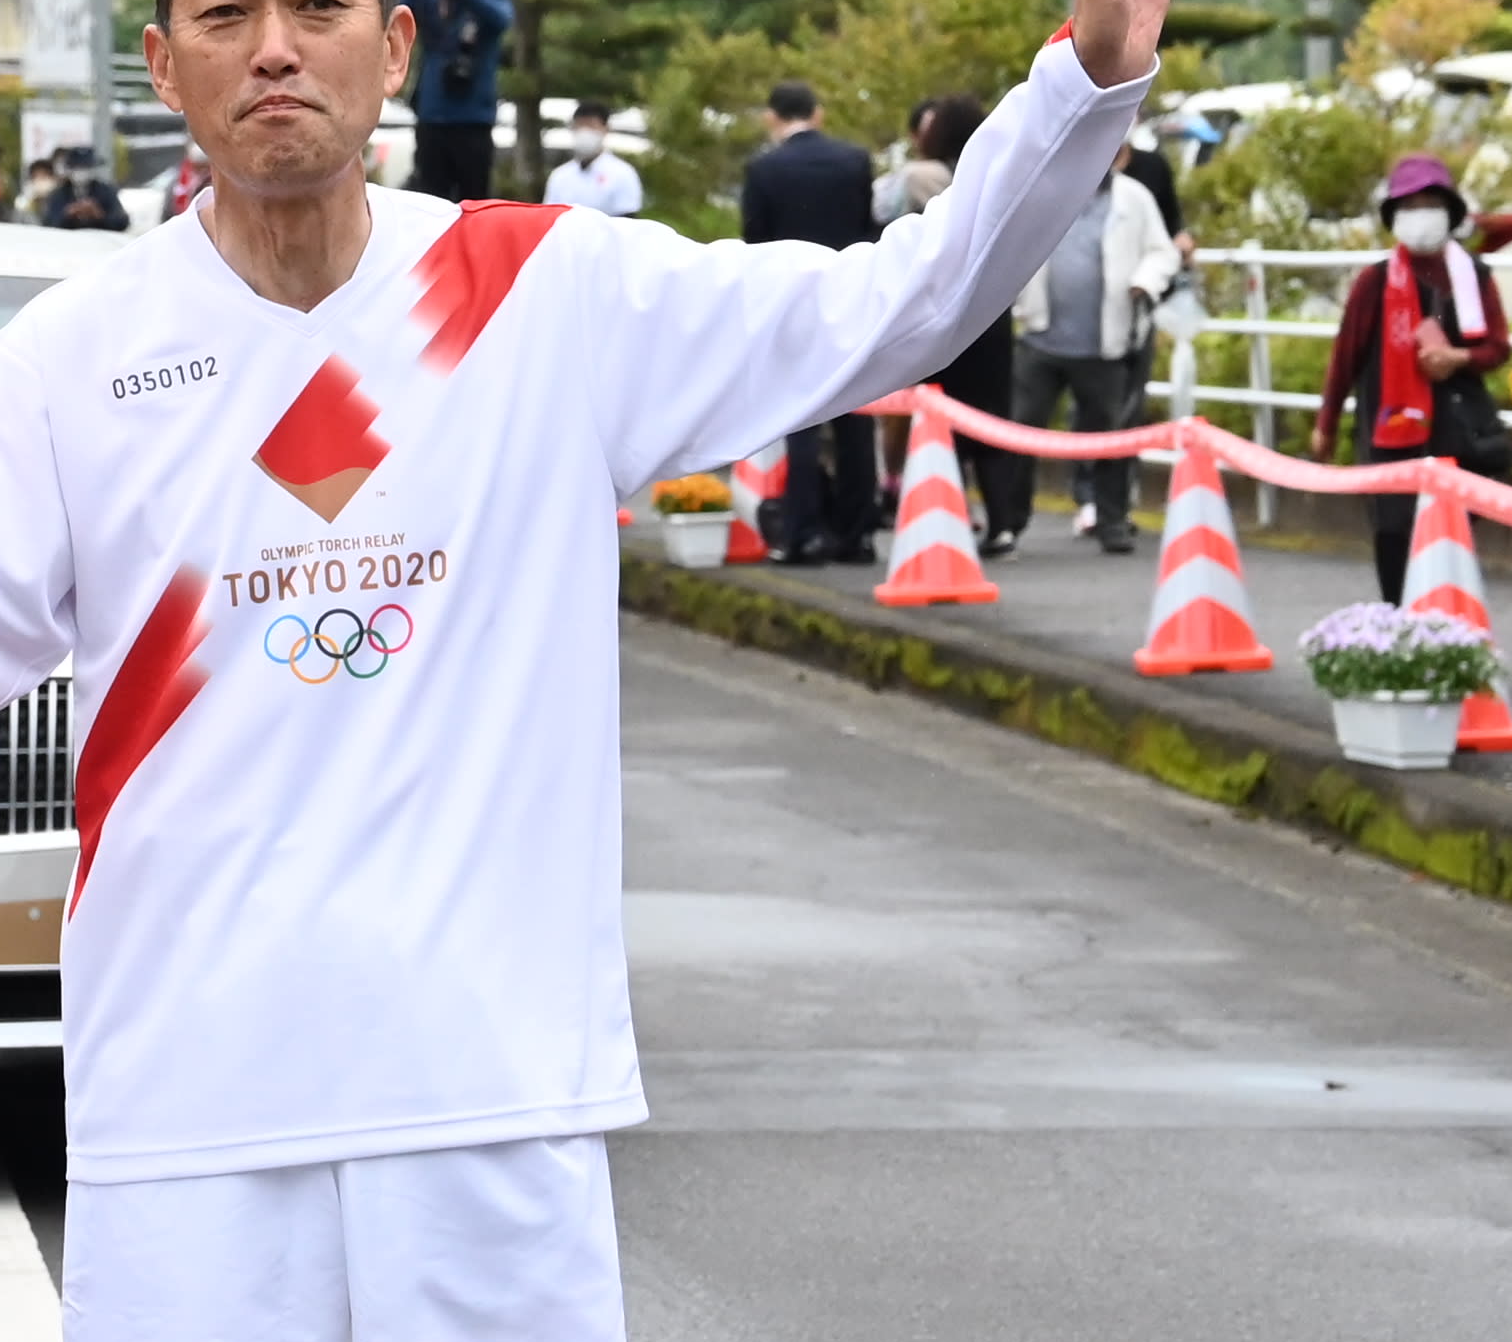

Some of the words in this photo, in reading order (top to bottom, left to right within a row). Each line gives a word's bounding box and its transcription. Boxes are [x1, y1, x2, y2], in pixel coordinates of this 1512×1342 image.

[112, 356, 218, 399] 0350102
[260, 541, 315, 562] OLYMPIC
[318, 535, 361, 552] TORCH
[364, 532, 406, 548] RELAY
[222, 559, 347, 607] TOKYO
[357, 549, 447, 591] 2020
